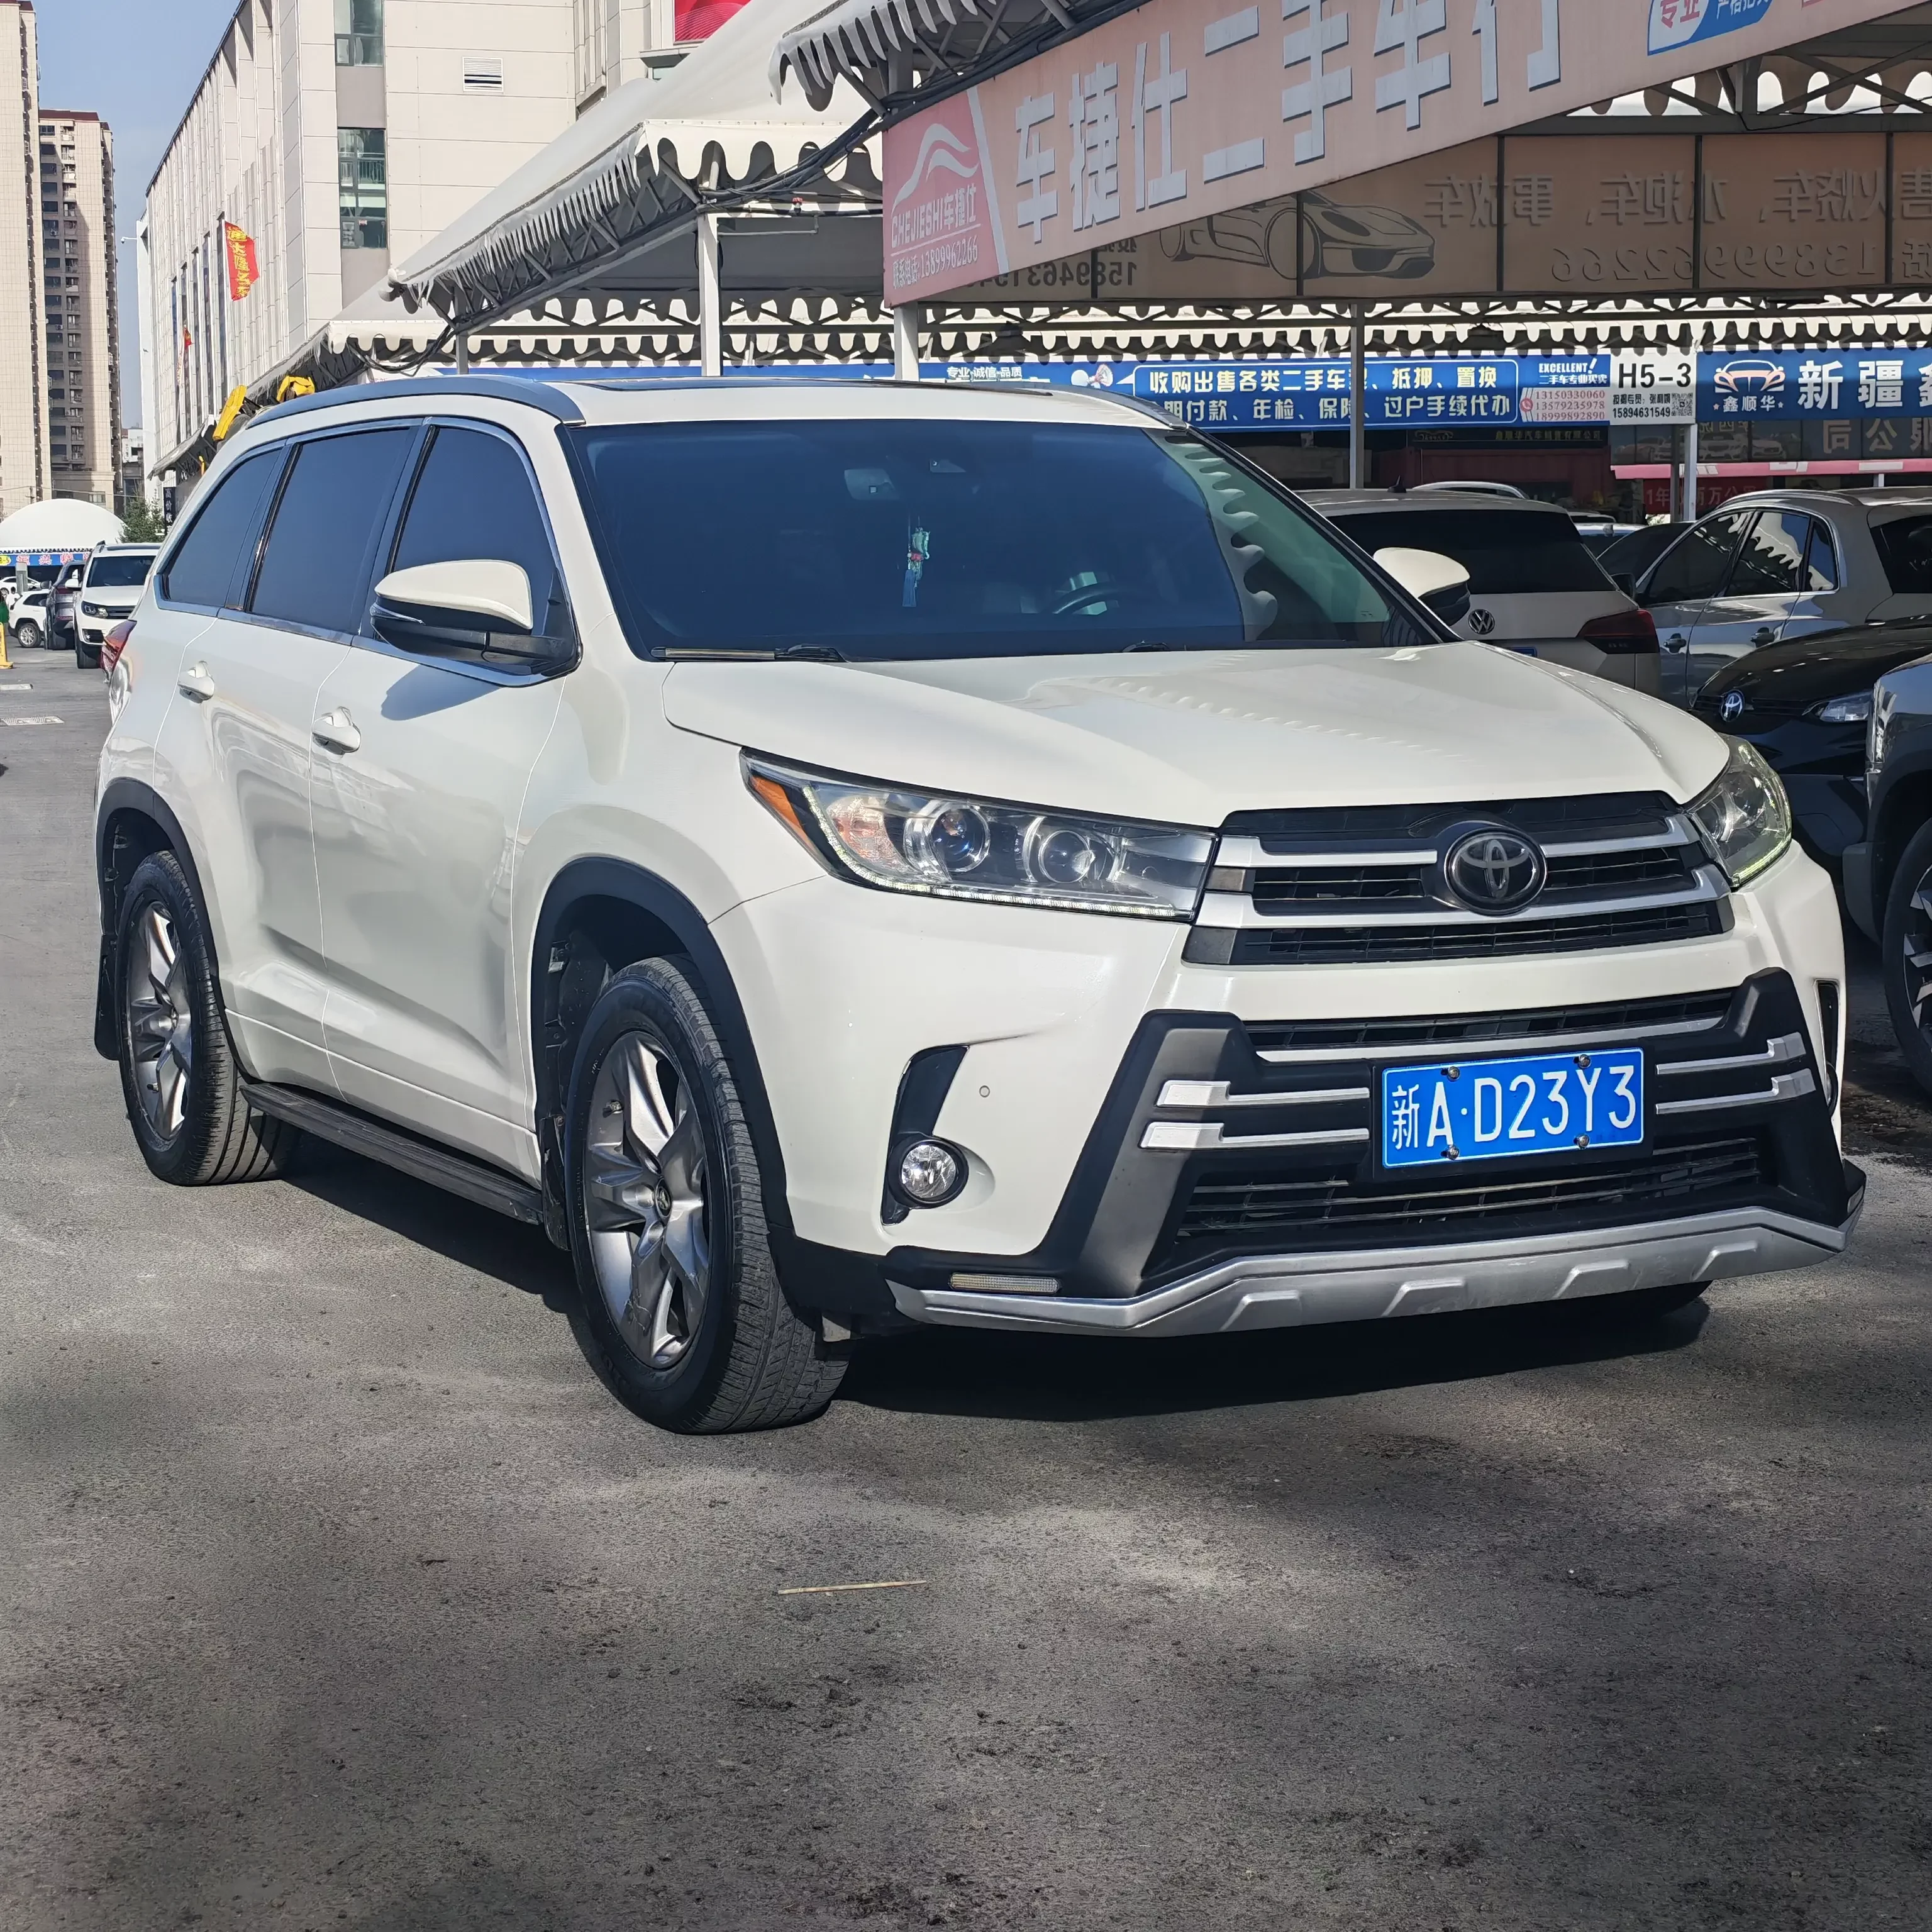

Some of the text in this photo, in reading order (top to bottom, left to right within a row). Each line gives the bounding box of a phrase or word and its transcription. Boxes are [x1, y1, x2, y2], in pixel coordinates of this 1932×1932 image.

[1618, 363, 1691, 388] H5-3
[1613, 407, 1670, 418] 15894631549
[1392, 1065, 1636, 1150] 新A·D23Y3
